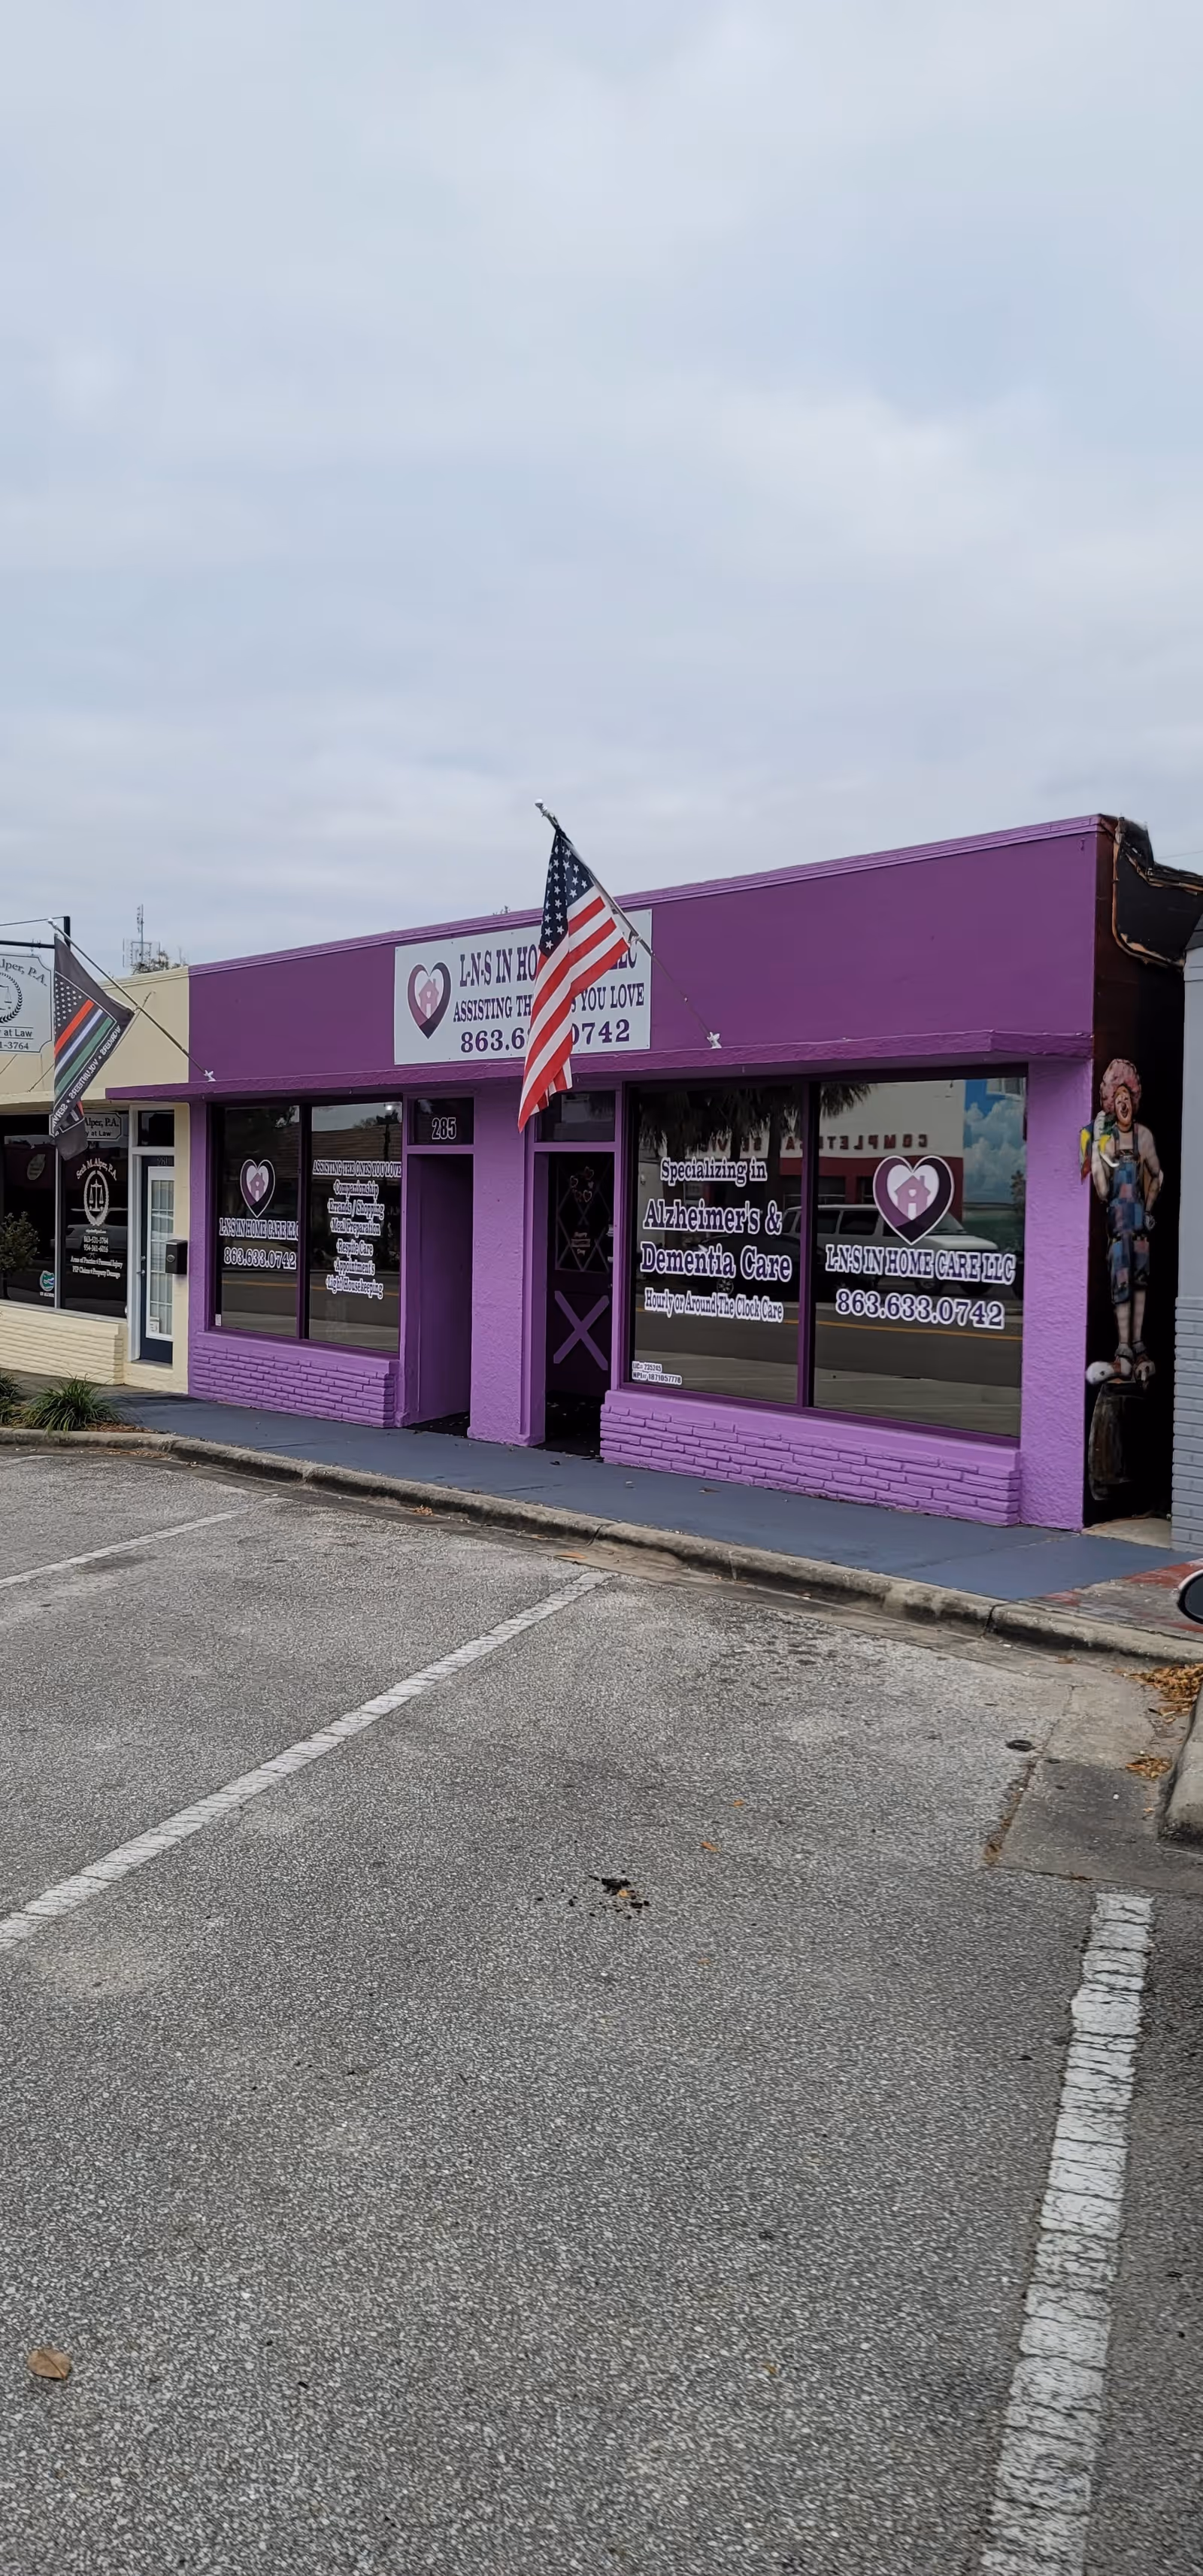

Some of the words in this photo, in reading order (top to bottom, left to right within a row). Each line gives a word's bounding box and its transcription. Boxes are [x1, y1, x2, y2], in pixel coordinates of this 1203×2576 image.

[0, 959, 24, 975] lper,
[459, 950, 492, 987] L-N-S
[495, 947, 513, 983] IN
[453, 996, 512, 1023] ASSISTING
[516, 994, 533, 1017] TH
[581, 986, 606, 1012] YOU
[611, 983, 644, 1009] LOVE
[4, 1029, 12, 1037] at
[15, 1029, 32, 1038] Law
[432, 1117, 456, 1140] 285
[313, 1160, 342, 1175] ASSISTING
[342, 1161, 355, 1176] THE
[355, 1161, 372, 1177] ONES
[372, 1161, 386, 1177] YOU
[385, 1162, 402, 1177] LOVE
[660, 1156, 747, 1186] Specializing
[749, 1156, 768, 1181] in
[334, 1179, 379, 1200] Companionship
[329, 1199, 352, 1214] Errands
[356, 1199, 384, 1220] Shopping
[643, 1199, 760, 1235] Alzheimer's
[765, 1200, 782, 1236] &
[219, 1217, 236, 1237] L-N-S
[236, 1218, 246, 1237] IN
[245, 1219, 267, 1238] HOME
[267, 1220, 286, 1240] CARE
[331, 1217, 347, 1233] Meal
[346, 1218, 381, 1238] Preparation
[224, 1247, 297, 1270] 863.633.0742
[338, 1238, 359, 1258] Respite
[359, 1240, 374, 1256] Care
[335, 1257, 375, 1276] Appointment's
[641, 1241, 736, 1278] Dementia
[741, 1245, 792, 1282] Care
[862, 1246, 884, 1275] IN
[885, 1247, 935, 1278] HOME
[935, 1250, 980, 1281] CARE
[981, 1253, 1017, 1285] LLC
[326, 1274, 344, 1294] Light
[343, 1277, 383, 1299] Housekeeping
[644, 1287, 674, 1318] Hourly
[674, 1293, 685, 1314] or
[684, 1290, 718, 1317] Around
[717, 1293, 735, 1318] The
[735, 1293, 761, 1320] Clock
[761, 1296, 783, 1323] Care
[835, 1288, 1005, 1329] 863.633.0742
